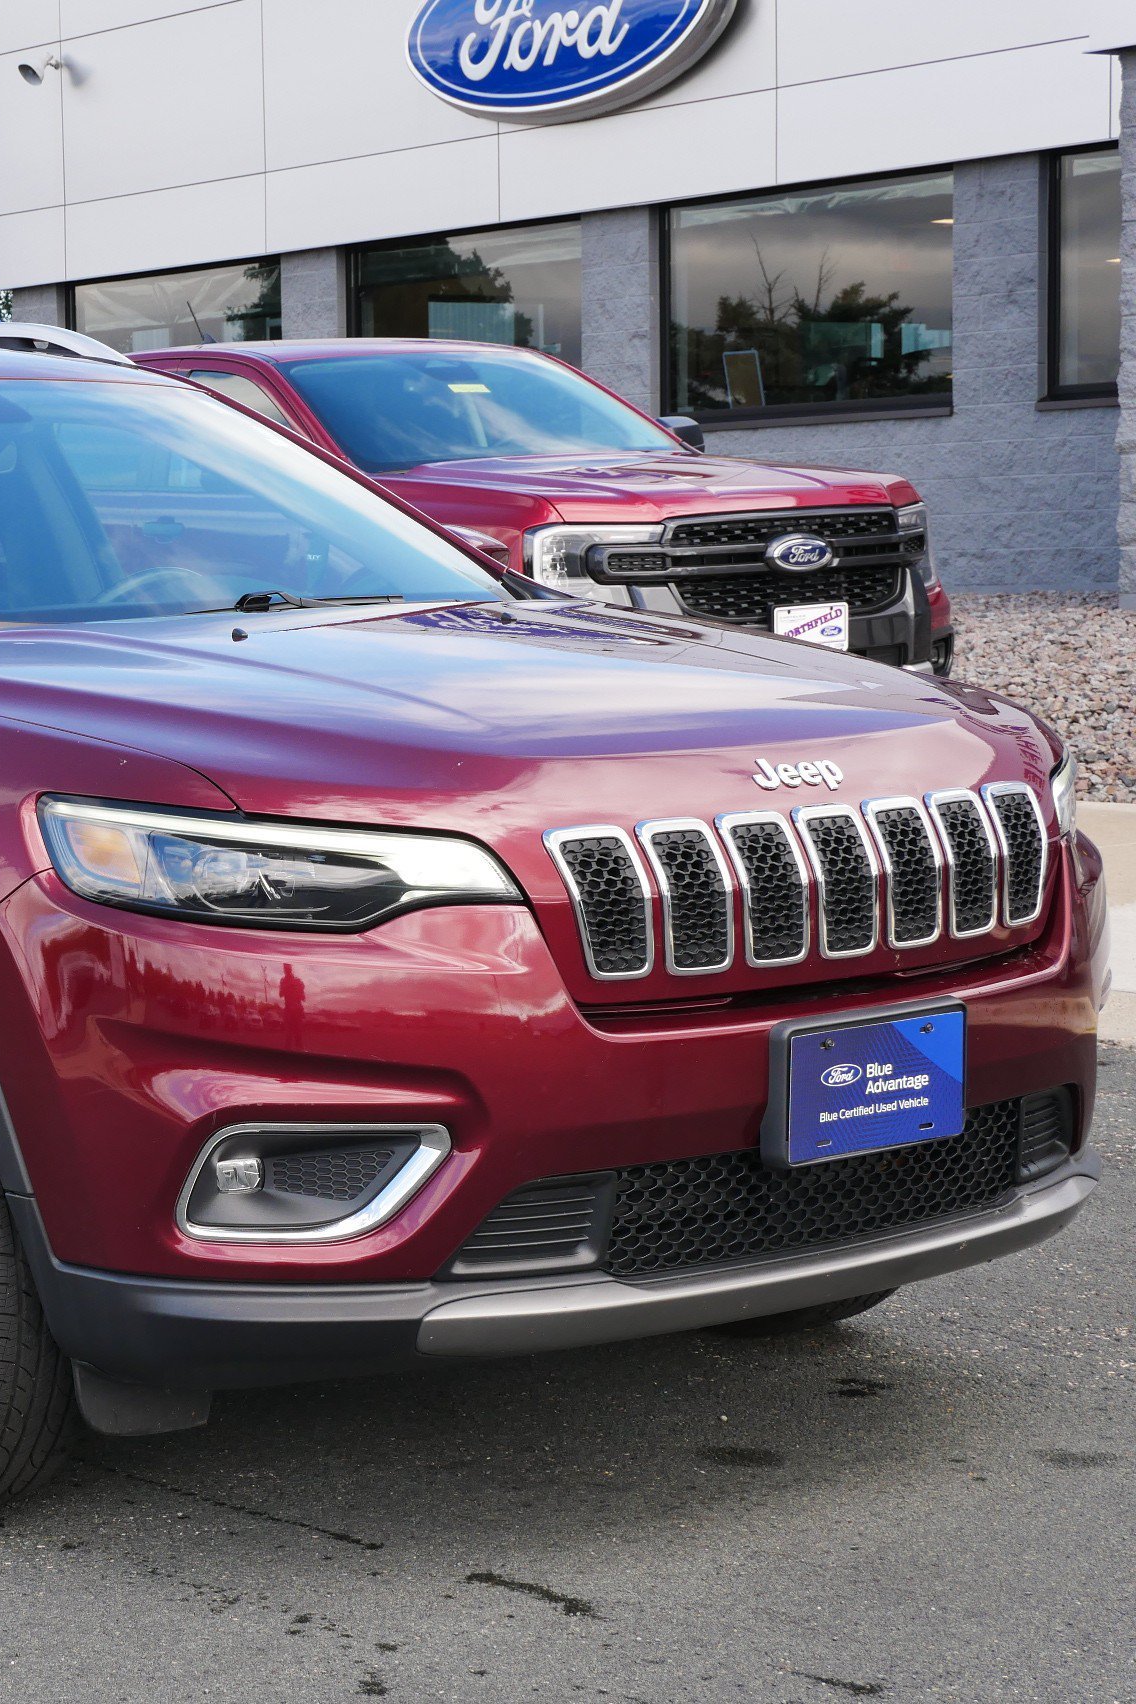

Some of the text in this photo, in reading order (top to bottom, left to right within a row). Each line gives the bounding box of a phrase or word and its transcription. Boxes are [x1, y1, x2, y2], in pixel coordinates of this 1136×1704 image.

[459, 0, 630, 81] Ford
[789, 546, 820, 563] Ford
[752, 758, 844, 791] Jeep
[828, 1067, 855, 1084] Ford
[866, 1062, 893, 1077] Blue
[865, 1074, 929, 1094] Advantage
[819, 1096, 929, 1123] Blue Certified Used Vehicle
